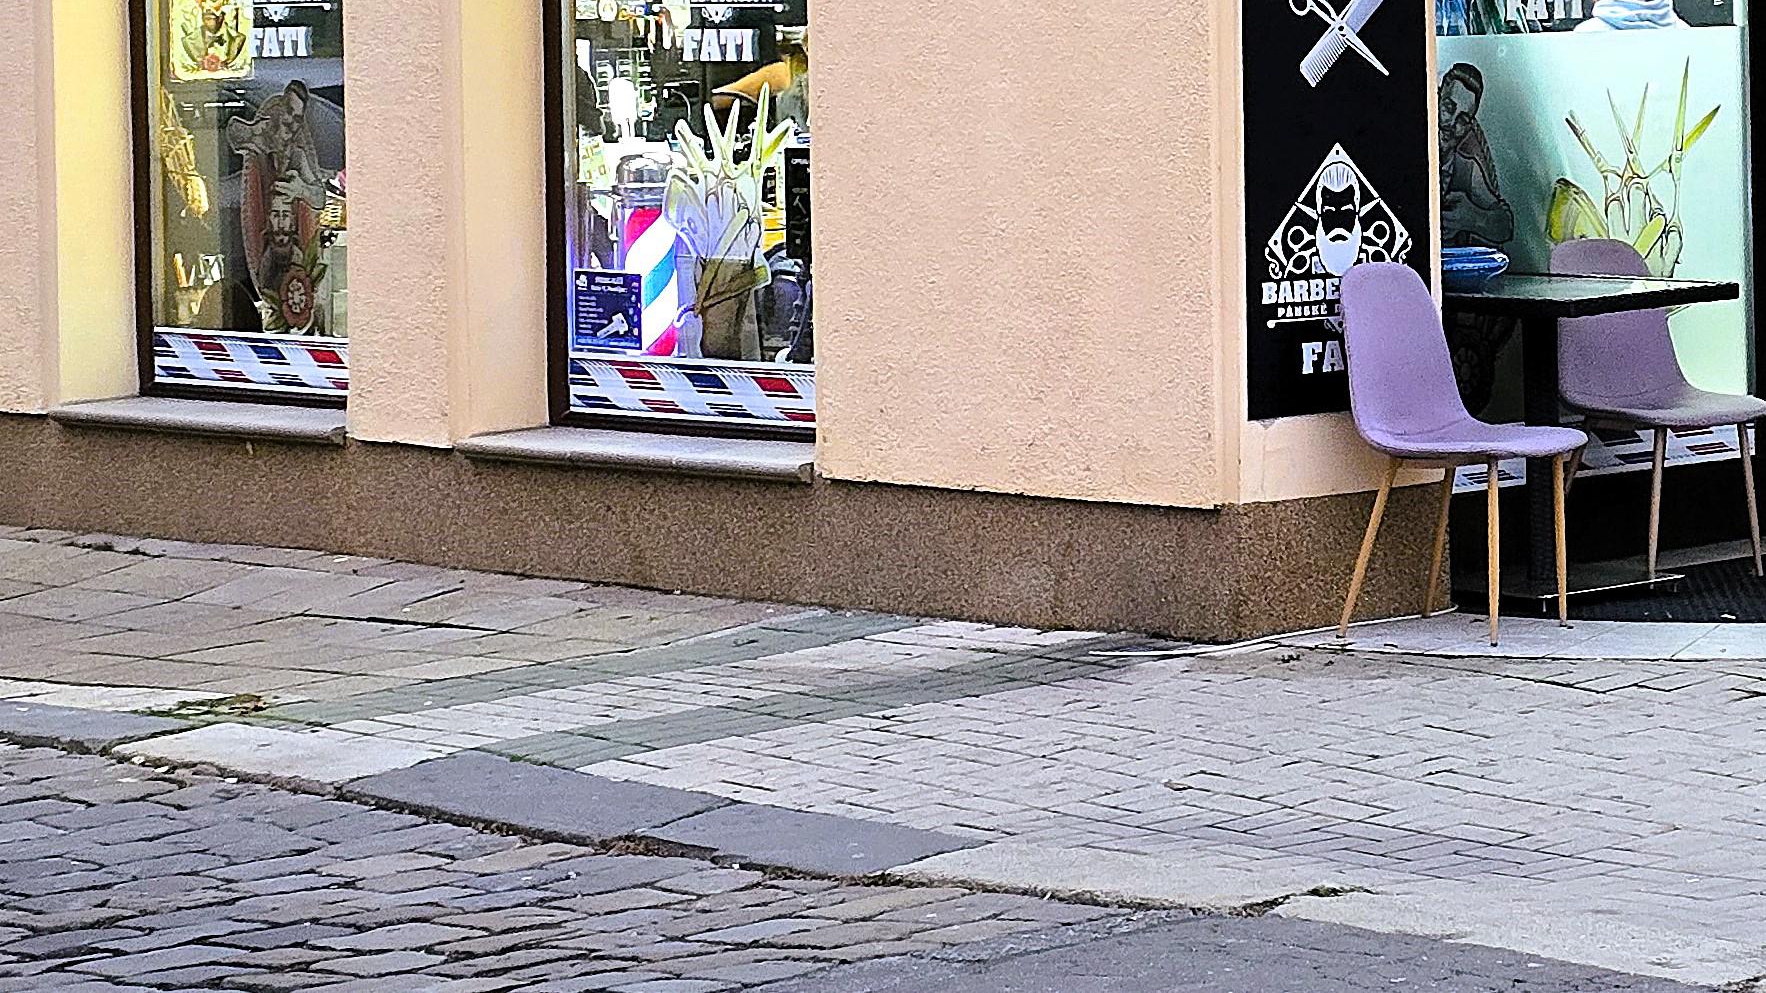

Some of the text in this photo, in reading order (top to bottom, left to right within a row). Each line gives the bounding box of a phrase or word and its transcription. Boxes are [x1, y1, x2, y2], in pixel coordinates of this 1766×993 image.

[248, 26, 307, 58] FATI
[683, 28, 755, 62] FATI
[1262, 277, 1341, 305] BARBE
[1278, 302, 1328, 318] PÁNSKÉ
[1302, 340, 1345, 375] FA
